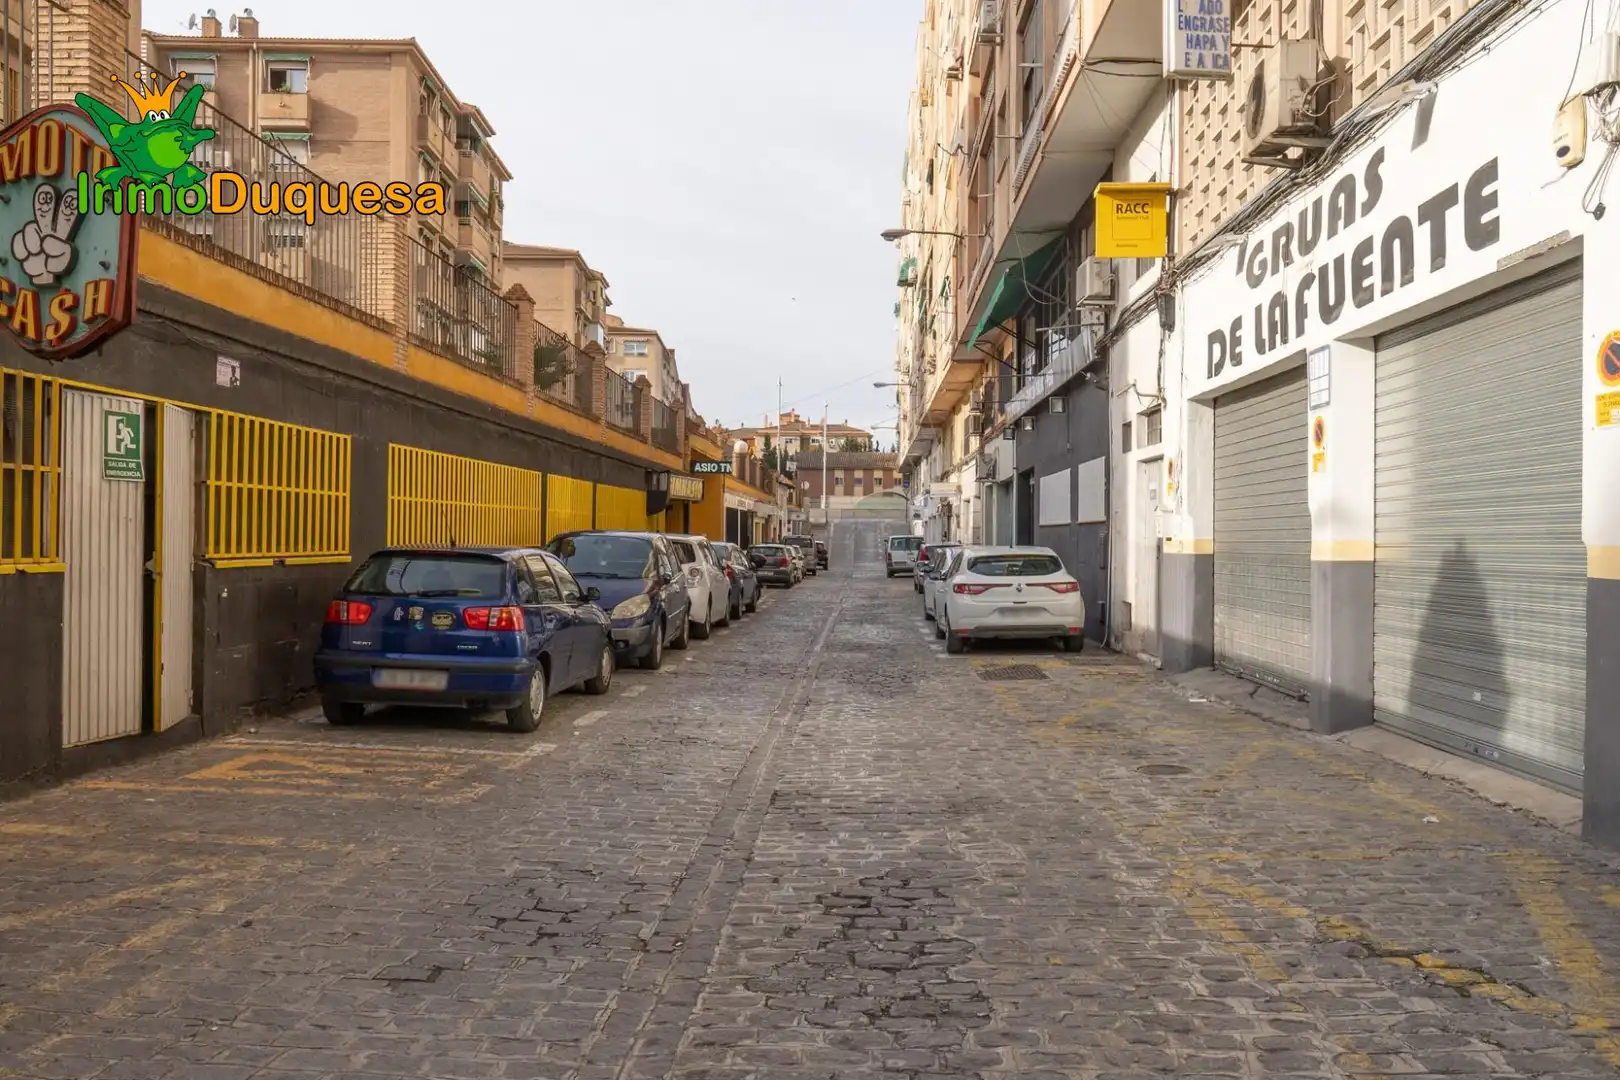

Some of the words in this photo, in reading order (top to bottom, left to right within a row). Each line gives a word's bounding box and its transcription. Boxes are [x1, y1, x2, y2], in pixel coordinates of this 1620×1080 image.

[1178, 15, 1230, 33] ENGRASE
[1116, 203, 1149, 214] RACC
[1245, 146, 1386, 290] GRUAS
[1207, 315, 1243, 380] DE
